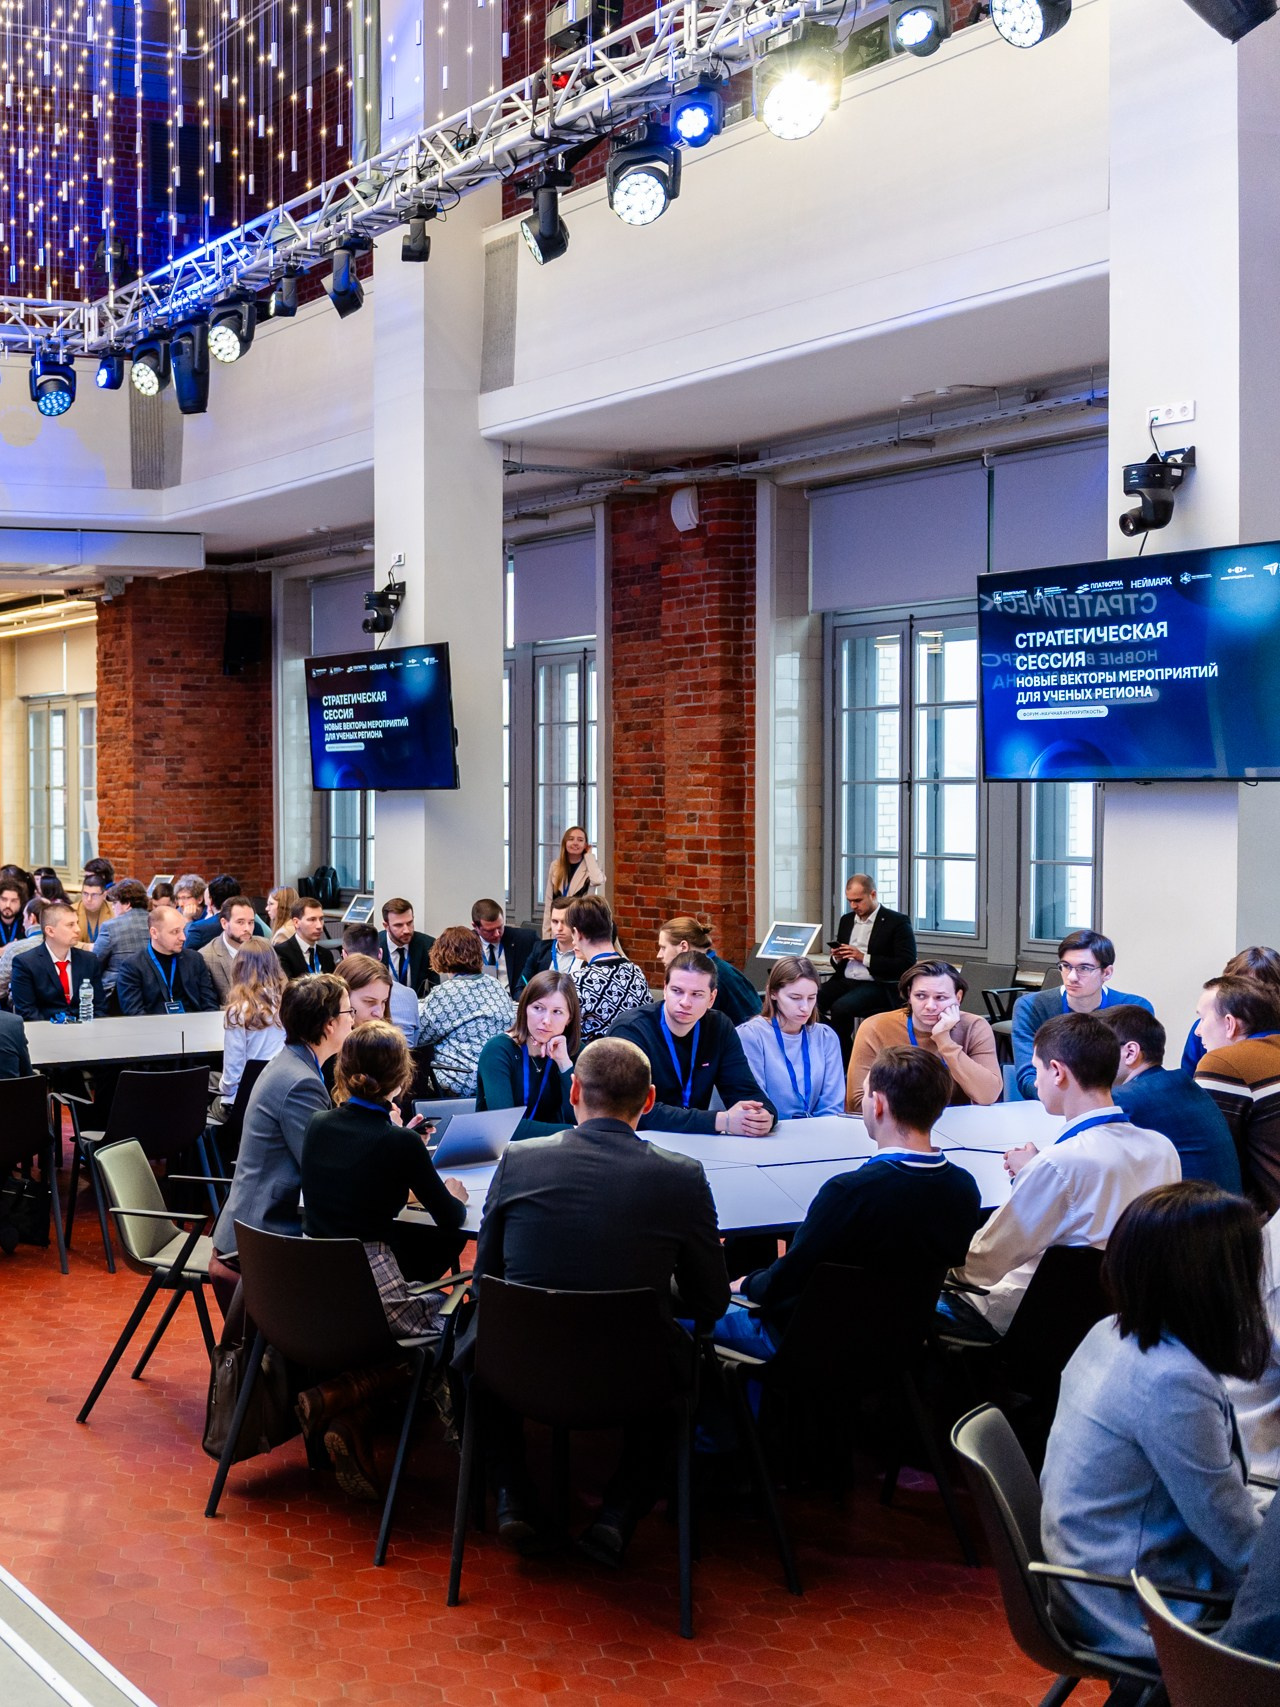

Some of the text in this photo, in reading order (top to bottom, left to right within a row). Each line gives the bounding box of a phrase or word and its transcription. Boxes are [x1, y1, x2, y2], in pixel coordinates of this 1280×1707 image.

[1090, 580, 1124, 590] ПЛАТФОРМА
[1130, 576, 1173, 589] НЕЙМАРК
[1015, 620, 1169, 649] СТРАТЕГИЧЕСКАЯ
[1015, 650, 1086, 671] СЕССИЯ
[1016, 674, 1058, 688] НОВЫЕ
[1060, 671, 1116, 686] ВЕКТОРЫ
[1119, 662, 1219, 682] МЕРОПРИЯТИЙ
[322, 690, 387, 706] СТРАТЕГИЧЕСКАЯ
[1016, 685, 1154, 705] ДЛЯ УЧЕНЫХ РЕГИОНА
[323, 708, 354, 721] СЕССИЯ
[324, 717, 409, 731] НОВЫЕ ВЕКТОРЫ МЕРОПРИЯТИЙ
[324, 730, 383, 742] ДЛЯ УЧЕНЫХ РЕГИОНА
